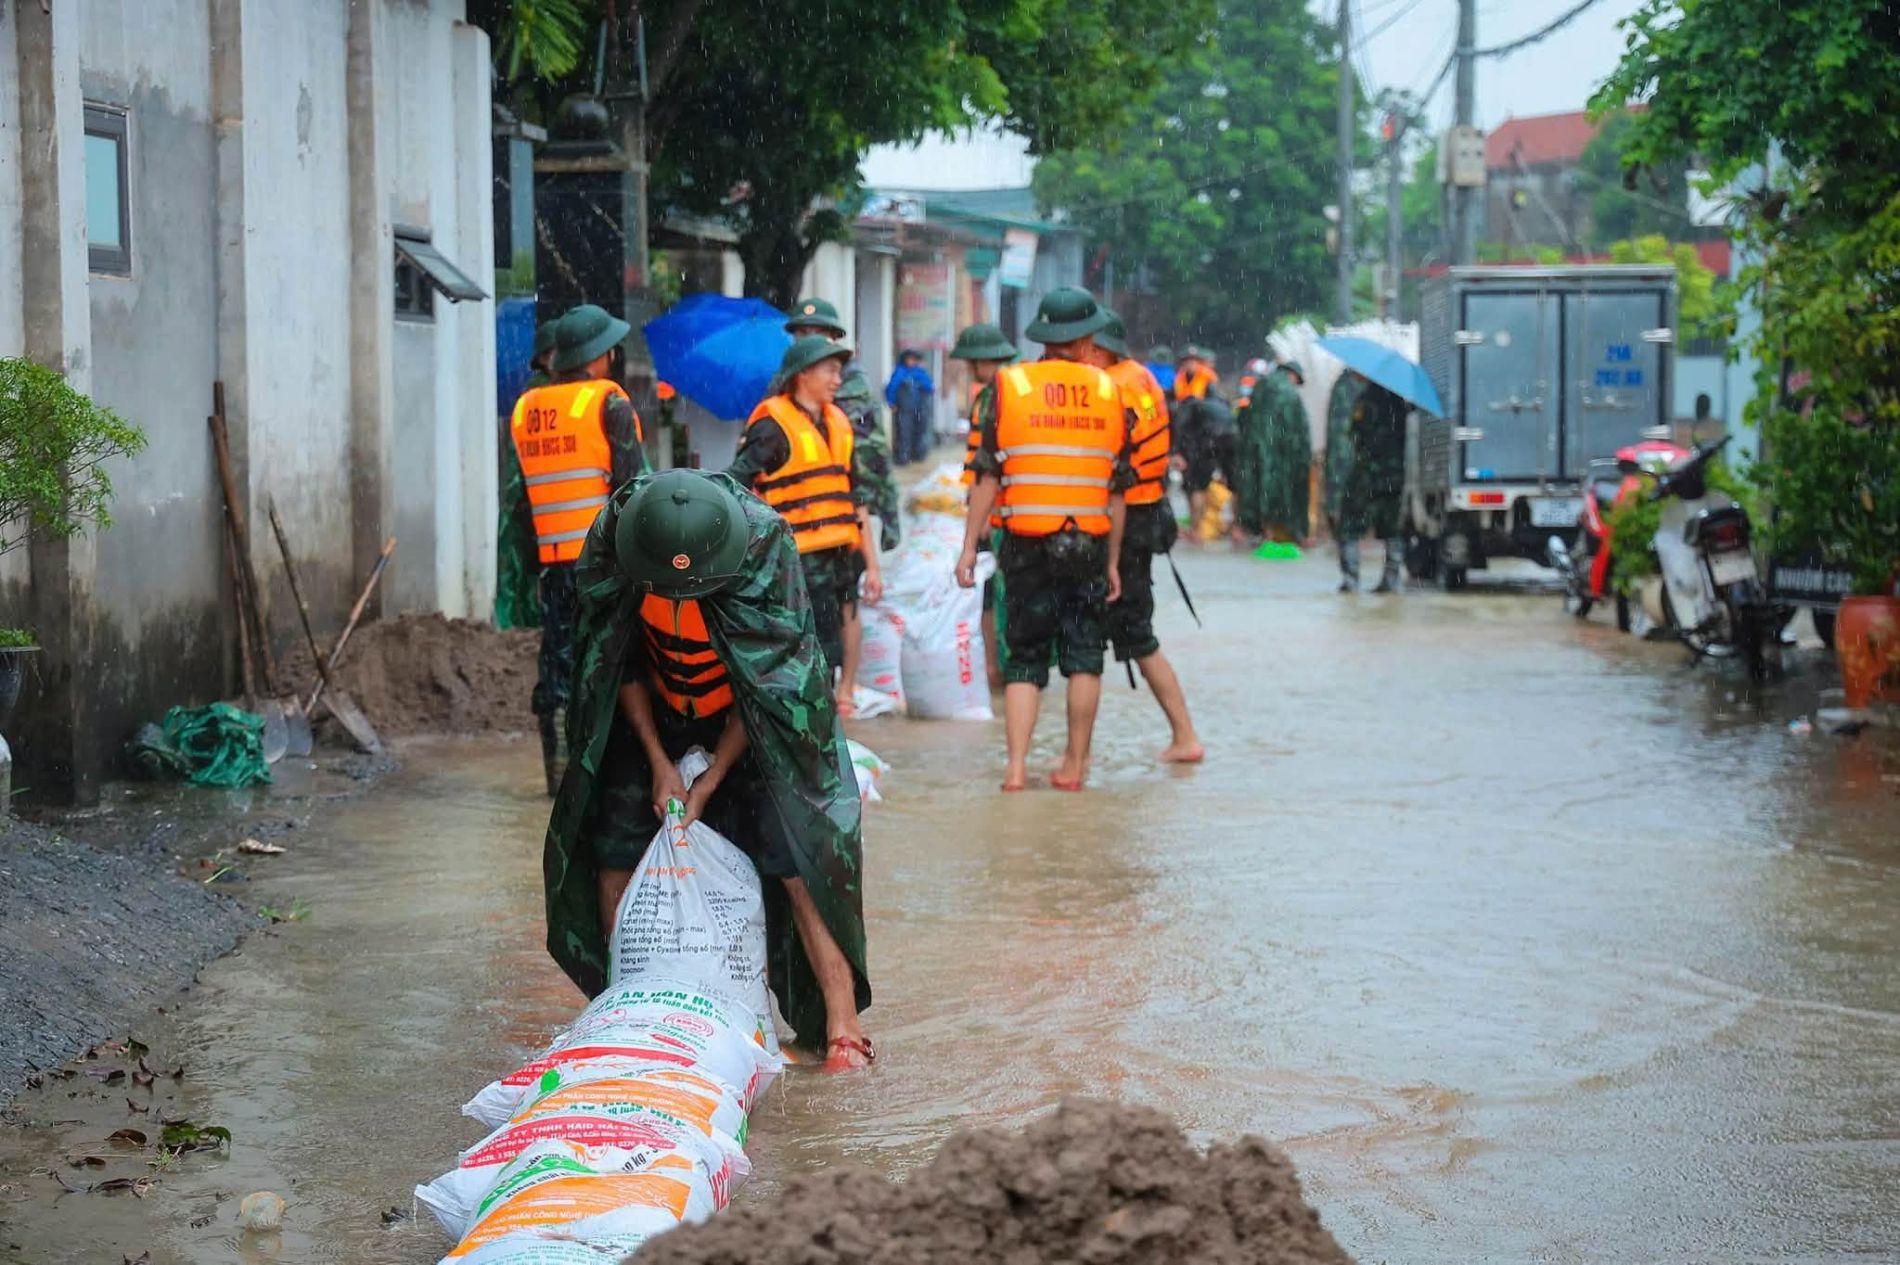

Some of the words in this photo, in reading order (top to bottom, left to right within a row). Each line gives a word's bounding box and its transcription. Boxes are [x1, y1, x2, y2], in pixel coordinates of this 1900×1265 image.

[1072, 385, 1089, 407] 12
[543, 409, 557, 431] 12
[682, 945, 698, 954] tổng
[532, 1125, 563, 1133] TNHH
[566, 1122, 594, 1130] HAID
[633, 1151, 648, 1167] kg
[533, 1210, 558, 1218] CÔNG
